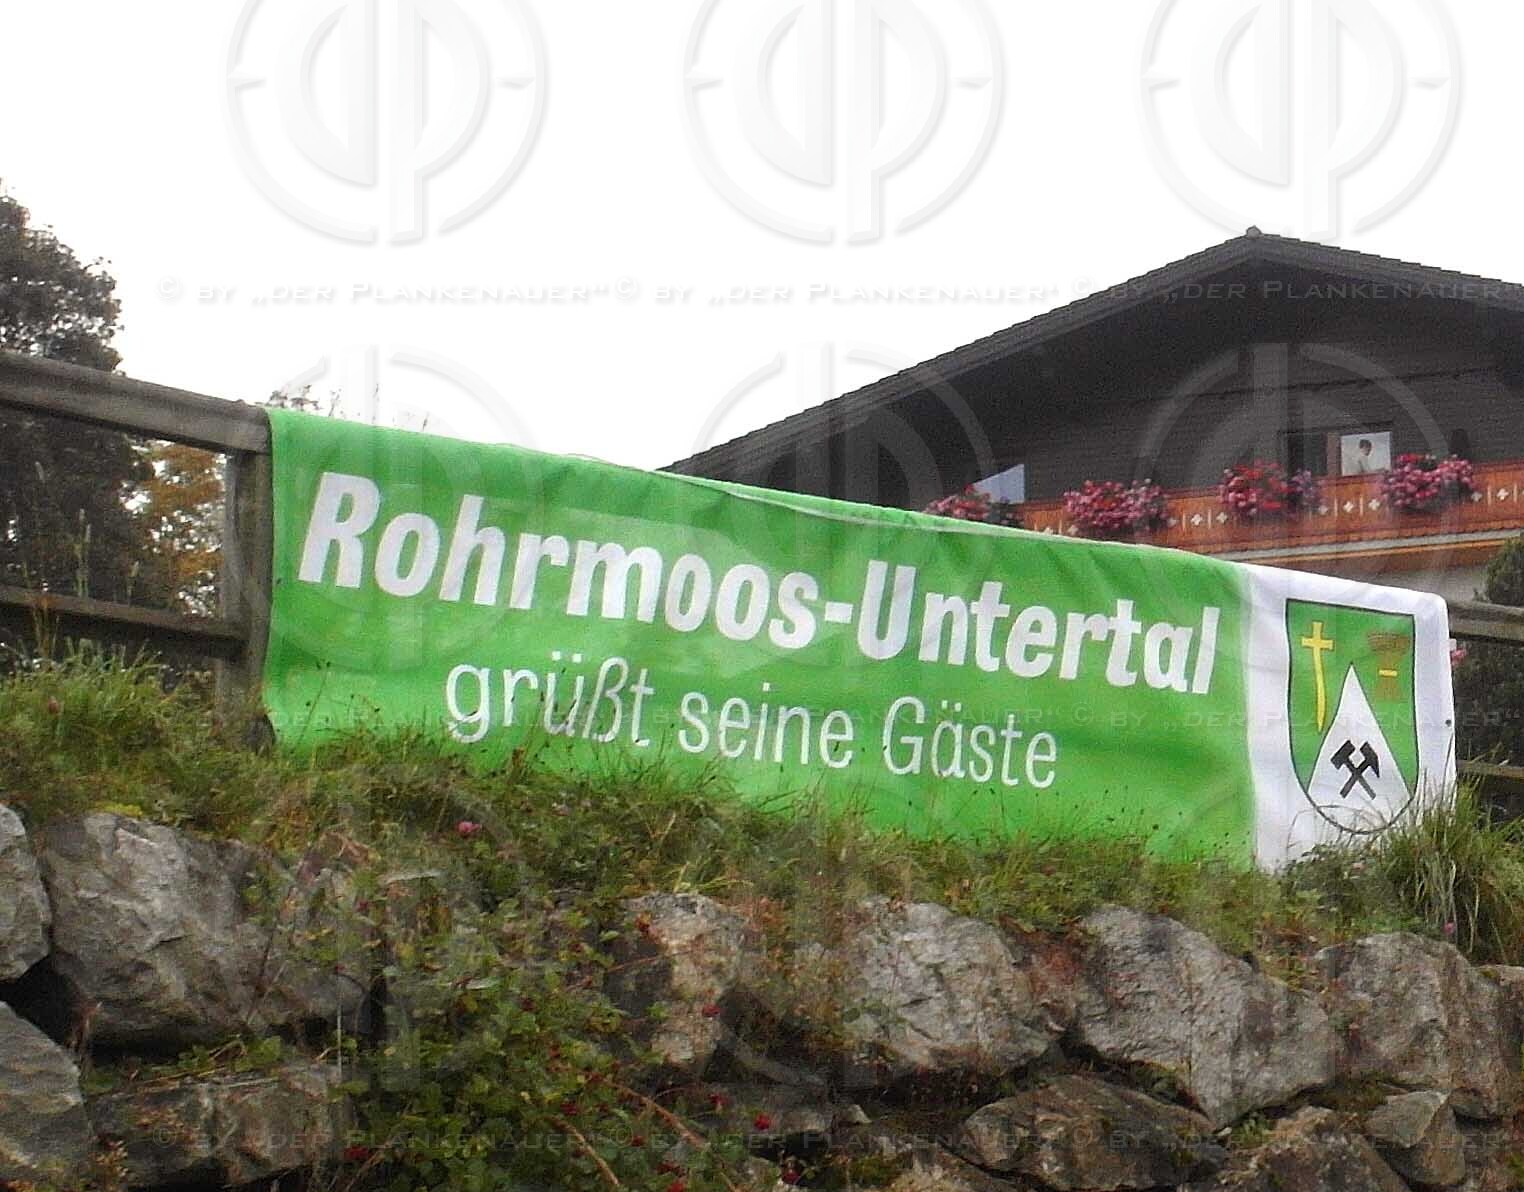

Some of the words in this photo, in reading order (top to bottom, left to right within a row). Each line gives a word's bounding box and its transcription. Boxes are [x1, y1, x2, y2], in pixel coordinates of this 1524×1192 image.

[299, 471, 1221, 695] Rohrmoos-Untertal
[446, 650, 655, 747] grüßt
[678, 682, 855, 768] seine
[882, 695, 1058, 789] Gäste
